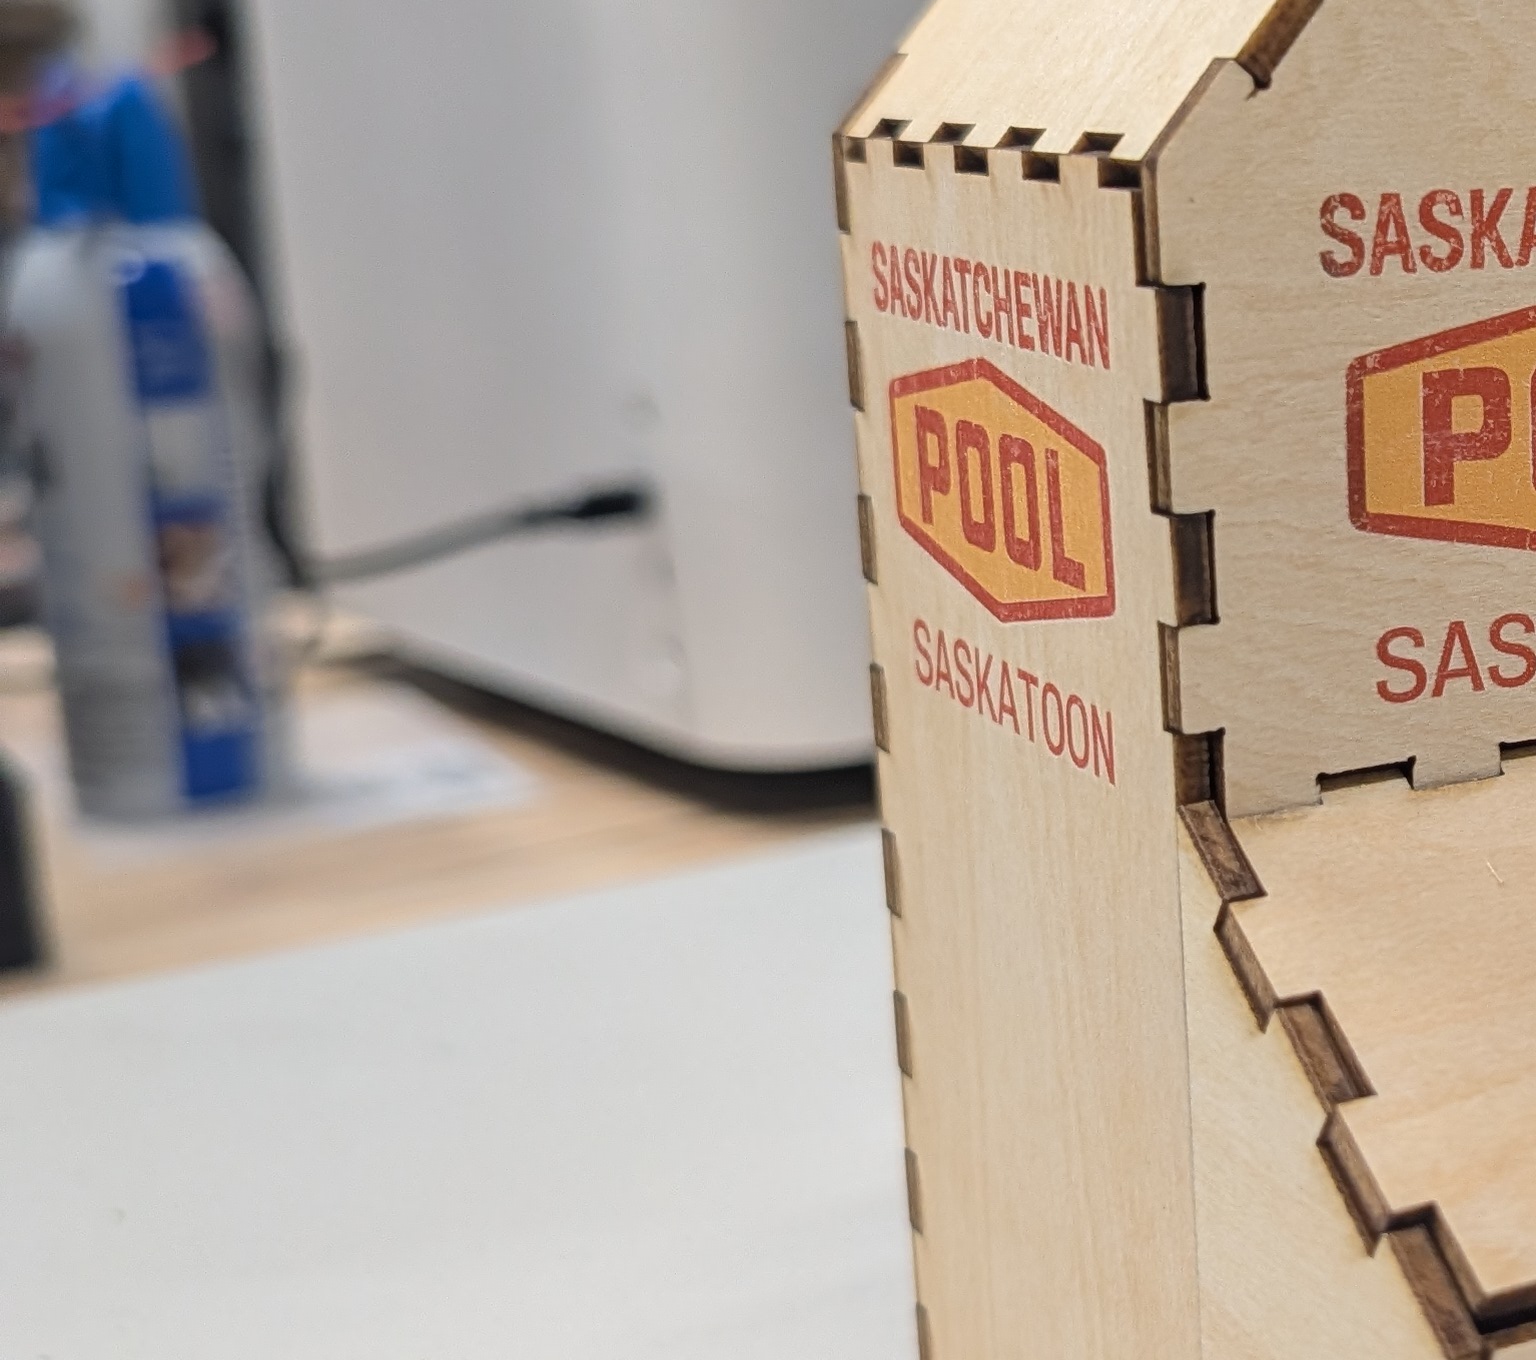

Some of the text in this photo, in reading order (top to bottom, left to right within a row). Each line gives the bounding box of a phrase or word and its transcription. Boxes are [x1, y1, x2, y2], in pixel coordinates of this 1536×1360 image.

[870, 240, 1112, 370] SASKATCHEWAN
[914, 403, 1087, 591] POOL
[913, 618, 1116, 787] SASKATOON
